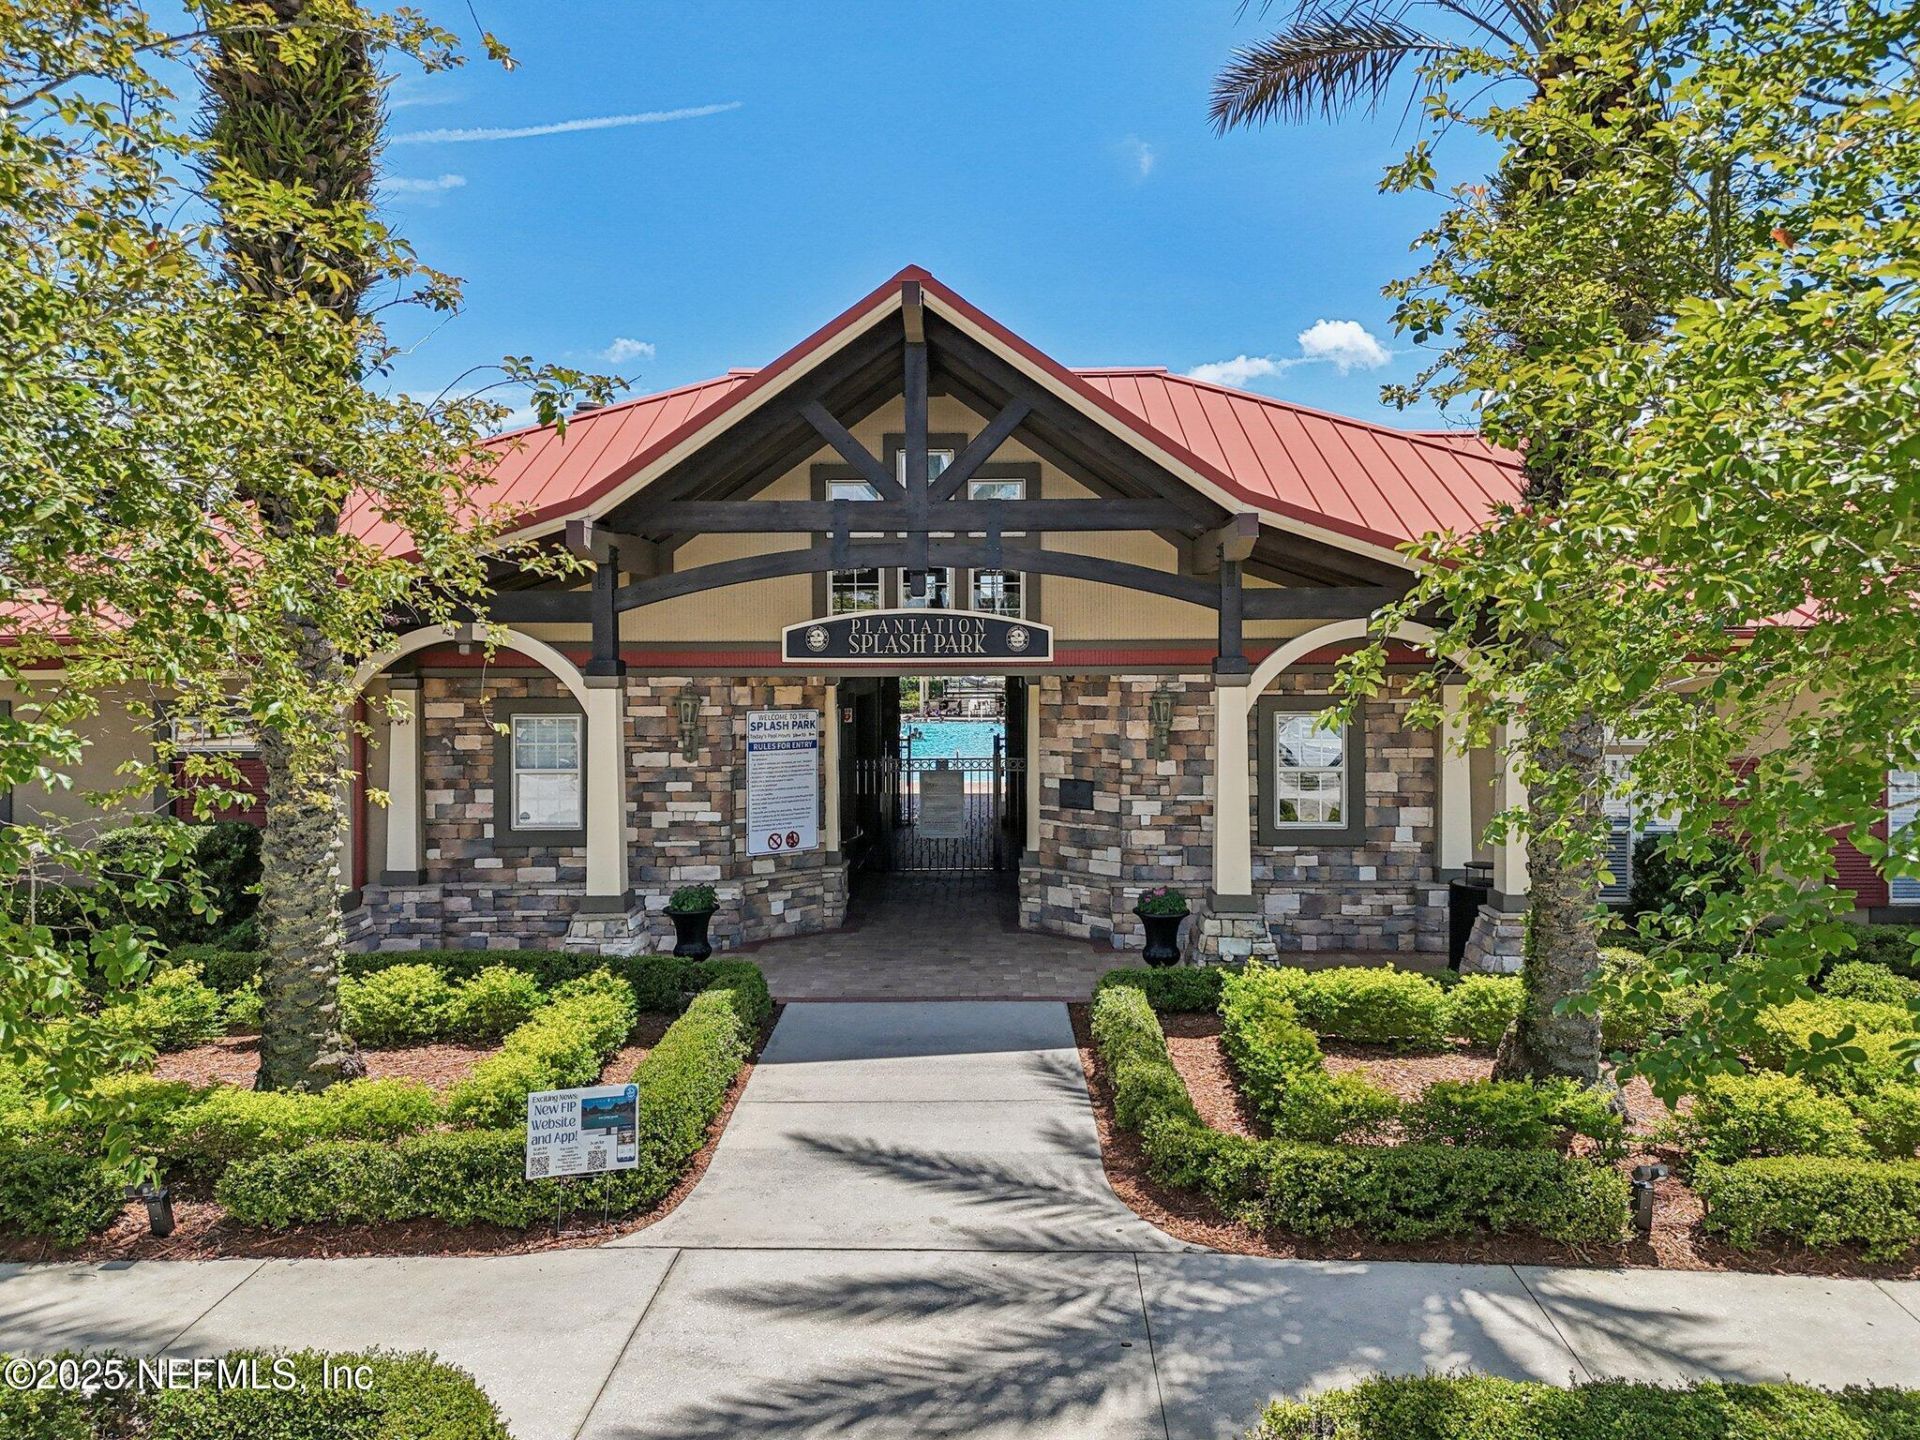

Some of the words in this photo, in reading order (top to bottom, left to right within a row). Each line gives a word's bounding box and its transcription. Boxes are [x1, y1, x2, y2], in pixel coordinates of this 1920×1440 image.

[850, 618, 986, 634] PLANTATION
[848, 633, 927, 654] SPLASH
[933, 632, 988, 654] PARK
[750, 721, 789, 731] SPLASH
[792, 720, 816, 729] PARK
[532, 1094, 558, 1104] Exciting
[534, 1104, 559, 1116] New
[561, 1101, 577, 1113] FIP
[531, 1116, 577, 1131] Website
[531, 1132, 552, 1146] and
[553, 1130, 578, 1144] App!
